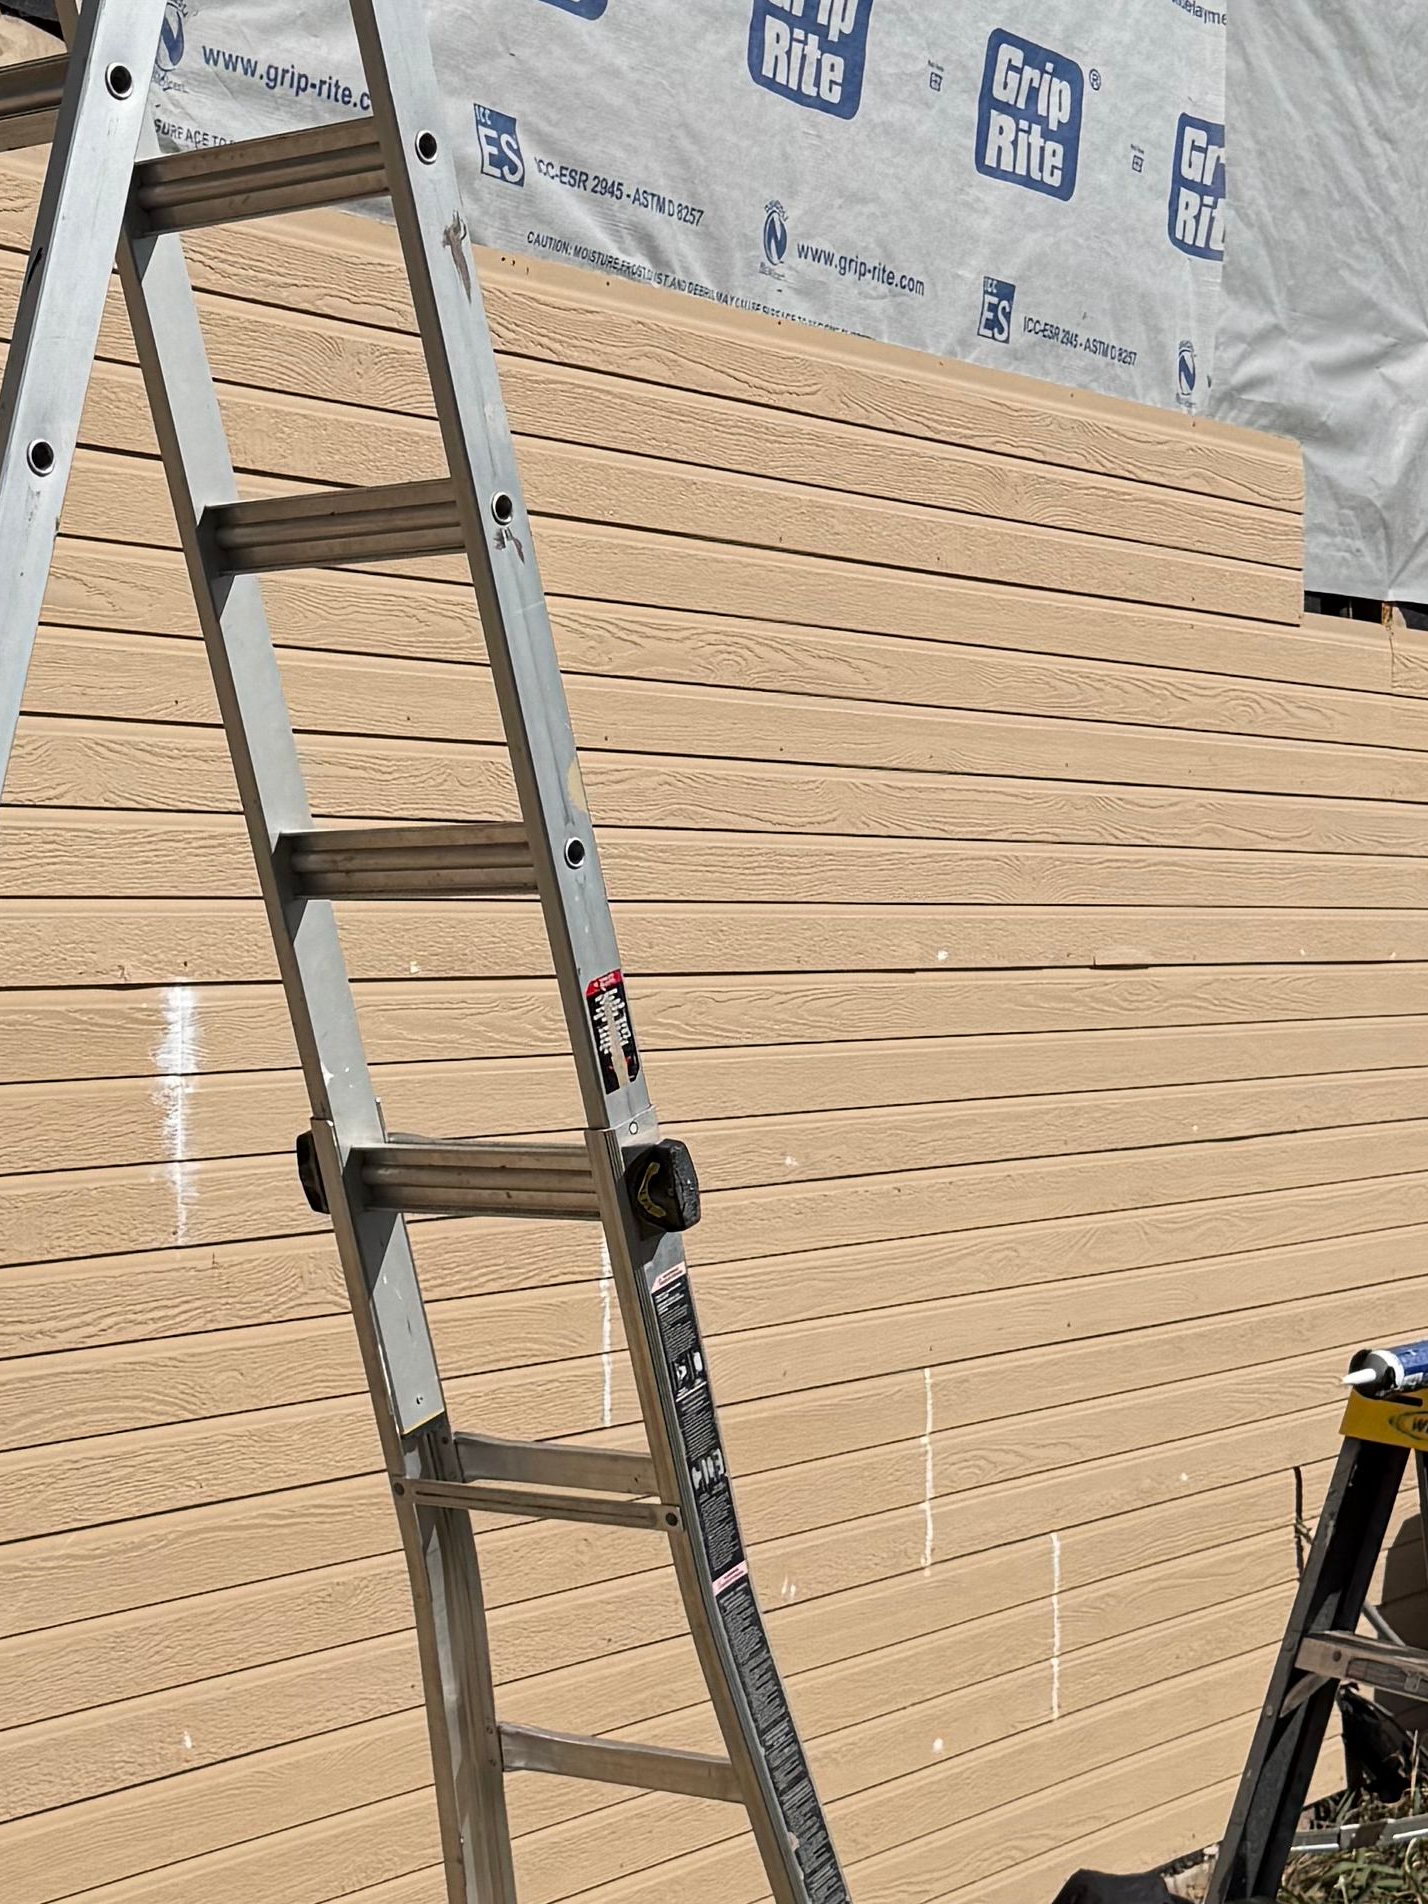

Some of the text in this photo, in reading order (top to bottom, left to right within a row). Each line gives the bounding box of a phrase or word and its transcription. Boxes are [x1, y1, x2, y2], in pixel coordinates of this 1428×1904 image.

[761, 14, 845, 105] Rite
[993, 43, 1072, 132] Grip
[477, 124, 525, 184] ES
[983, 107, 1064, 188] Rite
[590, 175, 624, 201] 2945
[631, 188, 666, 214] ASTM
[667, 199, 675, 218] D
[676, 203, 705, 228] 8257
[527, 230, 572, 256] CAUTION:
[796, 242, 925, 296] www.grip-rite.com
[978, 295, 1011, 342] ES
[1023, 315, 1061, 342] ICC-ESR
